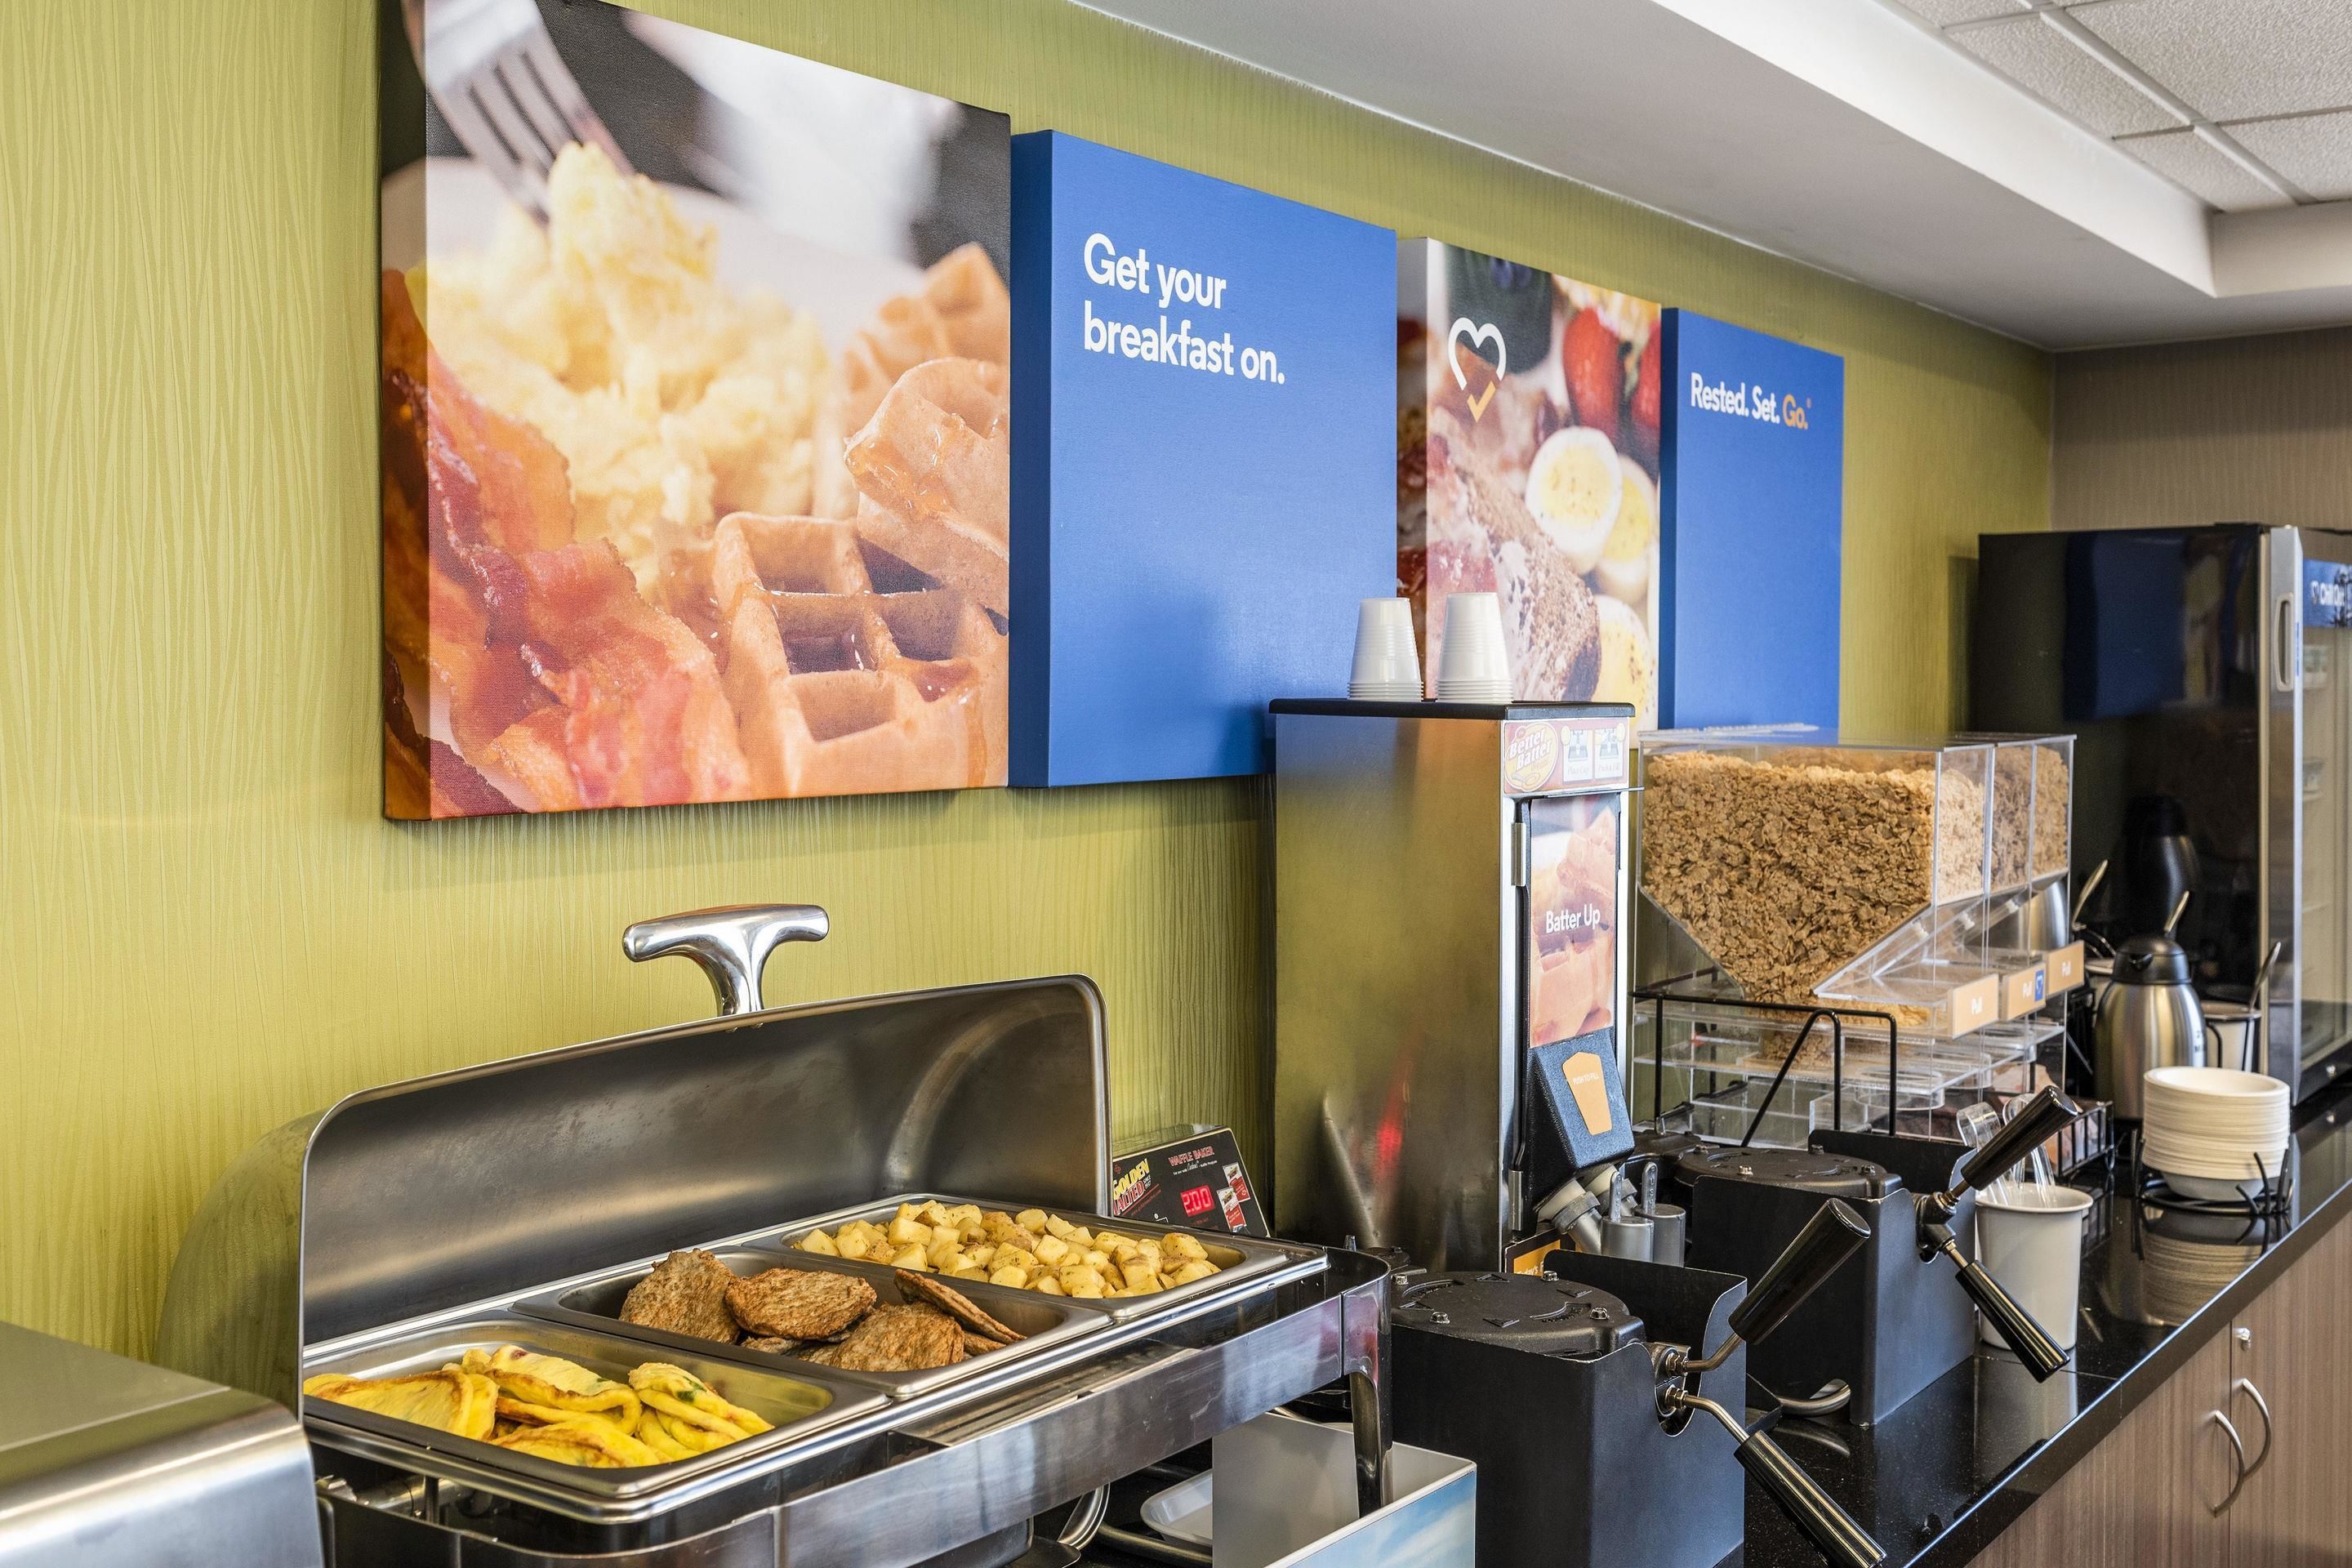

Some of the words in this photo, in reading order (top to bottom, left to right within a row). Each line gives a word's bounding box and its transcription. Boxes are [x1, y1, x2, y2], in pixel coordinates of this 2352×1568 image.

[1084, 233, 1150, 294] Get
[1156, 264, 1227, 309] your
[1084, 300, 1234, 376] breakfast
[1241, 347, 1285, 385] on.
[1690, 372, 1749, 417] Rested.
[1752, 385, 1780, 424] Set.
[1509, 726, 1547, 760] Better
[1517, 738, 1552, 771] Batter
[1546, 909, 1582, 933] Batter
[1584, 903, 1601, 929] Up
[1168, 1152, 1194, 1166] WAFFLE
[1113, 1158, 1150, 1200] GOLDEN
